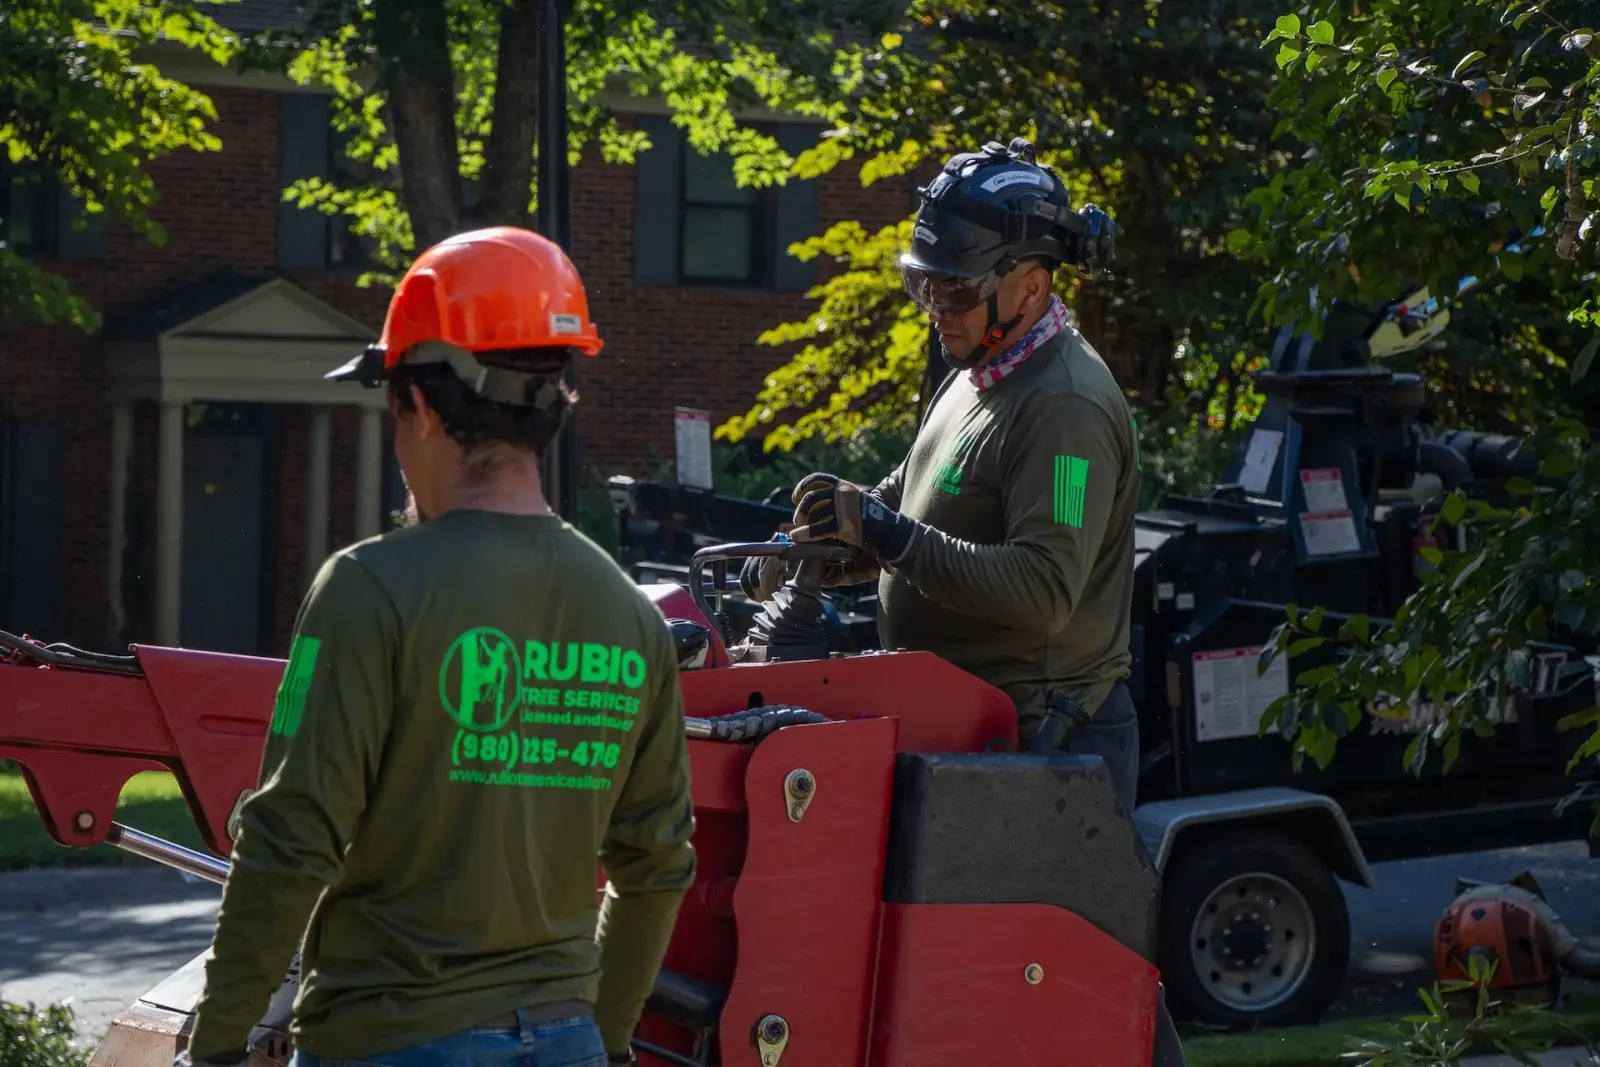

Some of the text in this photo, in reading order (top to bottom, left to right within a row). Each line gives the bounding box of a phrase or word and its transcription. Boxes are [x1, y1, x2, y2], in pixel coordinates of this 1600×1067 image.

[523, 640, 647, 688] RUBIO
[521, 687, 560, 706] TREE
[572, 712, 600, 726] and
[451, 729, 518, 771] (980)
